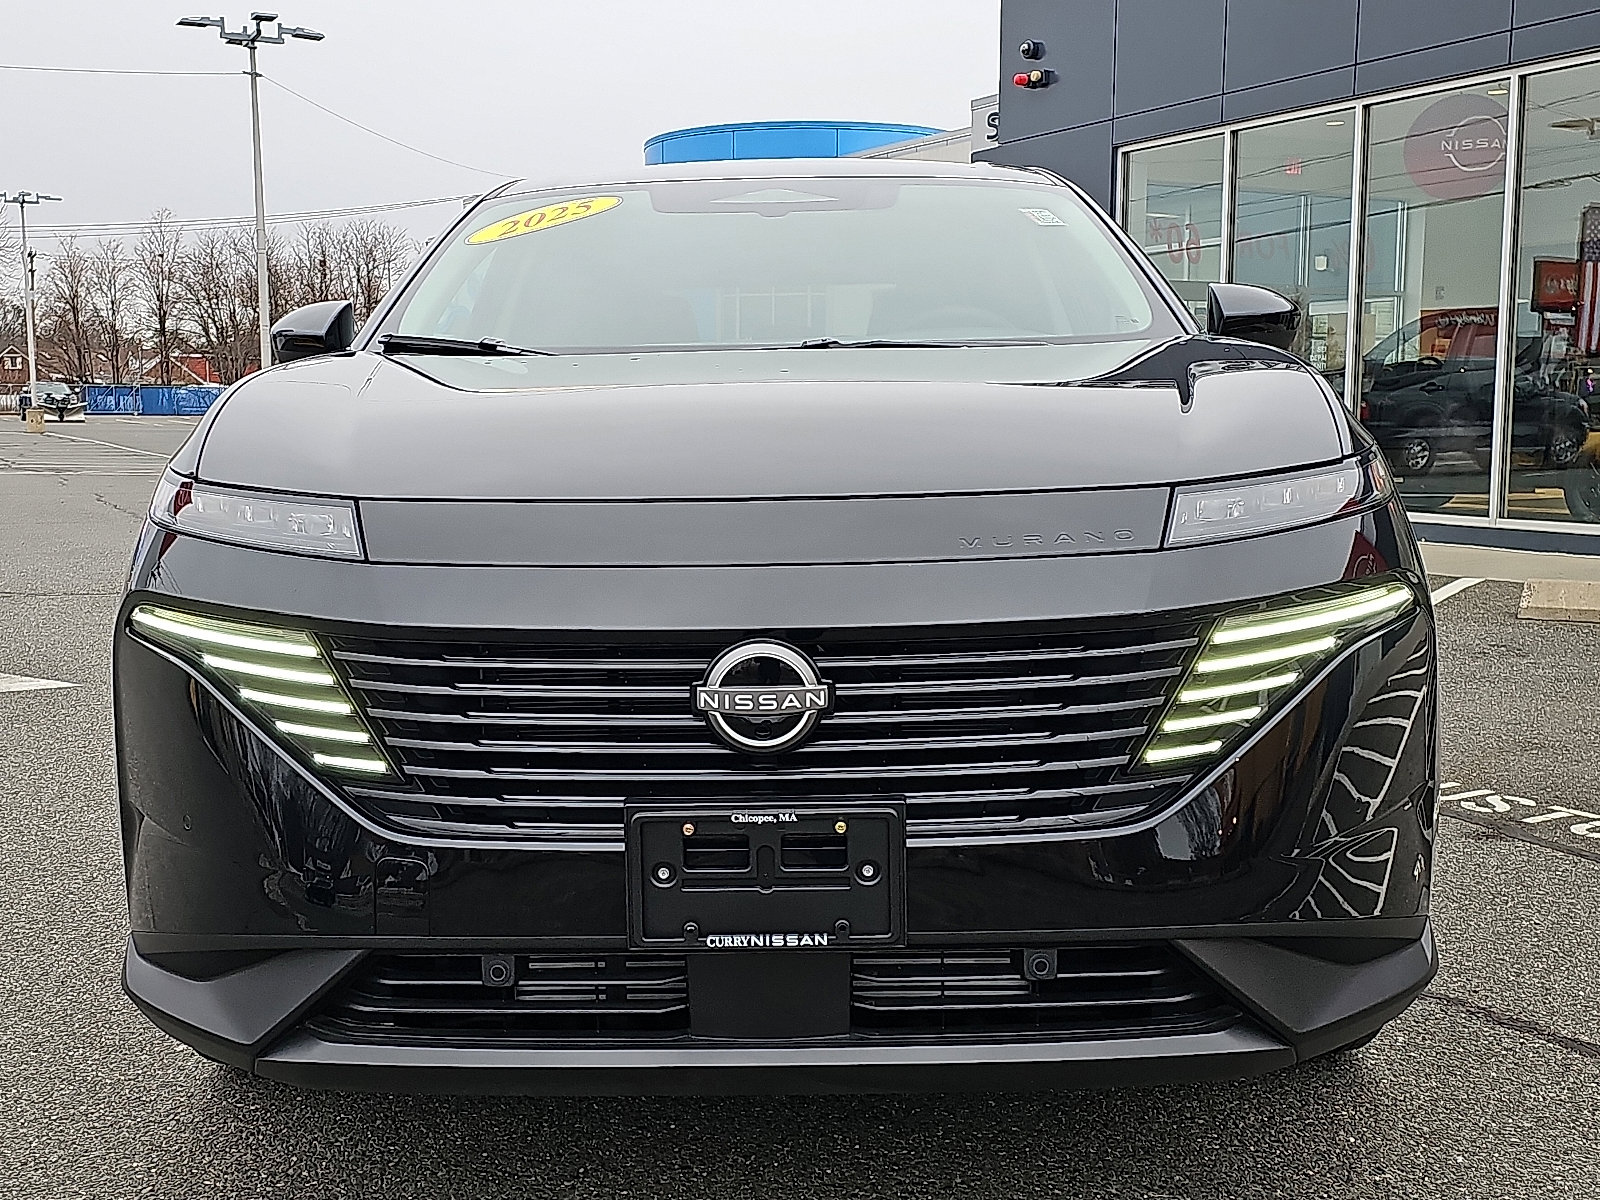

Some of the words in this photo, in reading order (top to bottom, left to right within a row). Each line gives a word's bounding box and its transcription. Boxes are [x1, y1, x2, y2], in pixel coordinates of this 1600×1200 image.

[499, 200, 593, 237] 2025
[959, 528, 1135, 548] MURANO
[700, 690, 825, 710] NISSAN
[731, 813, 777, 824] Chicopee,
[779, 813, 798, 822] MA
